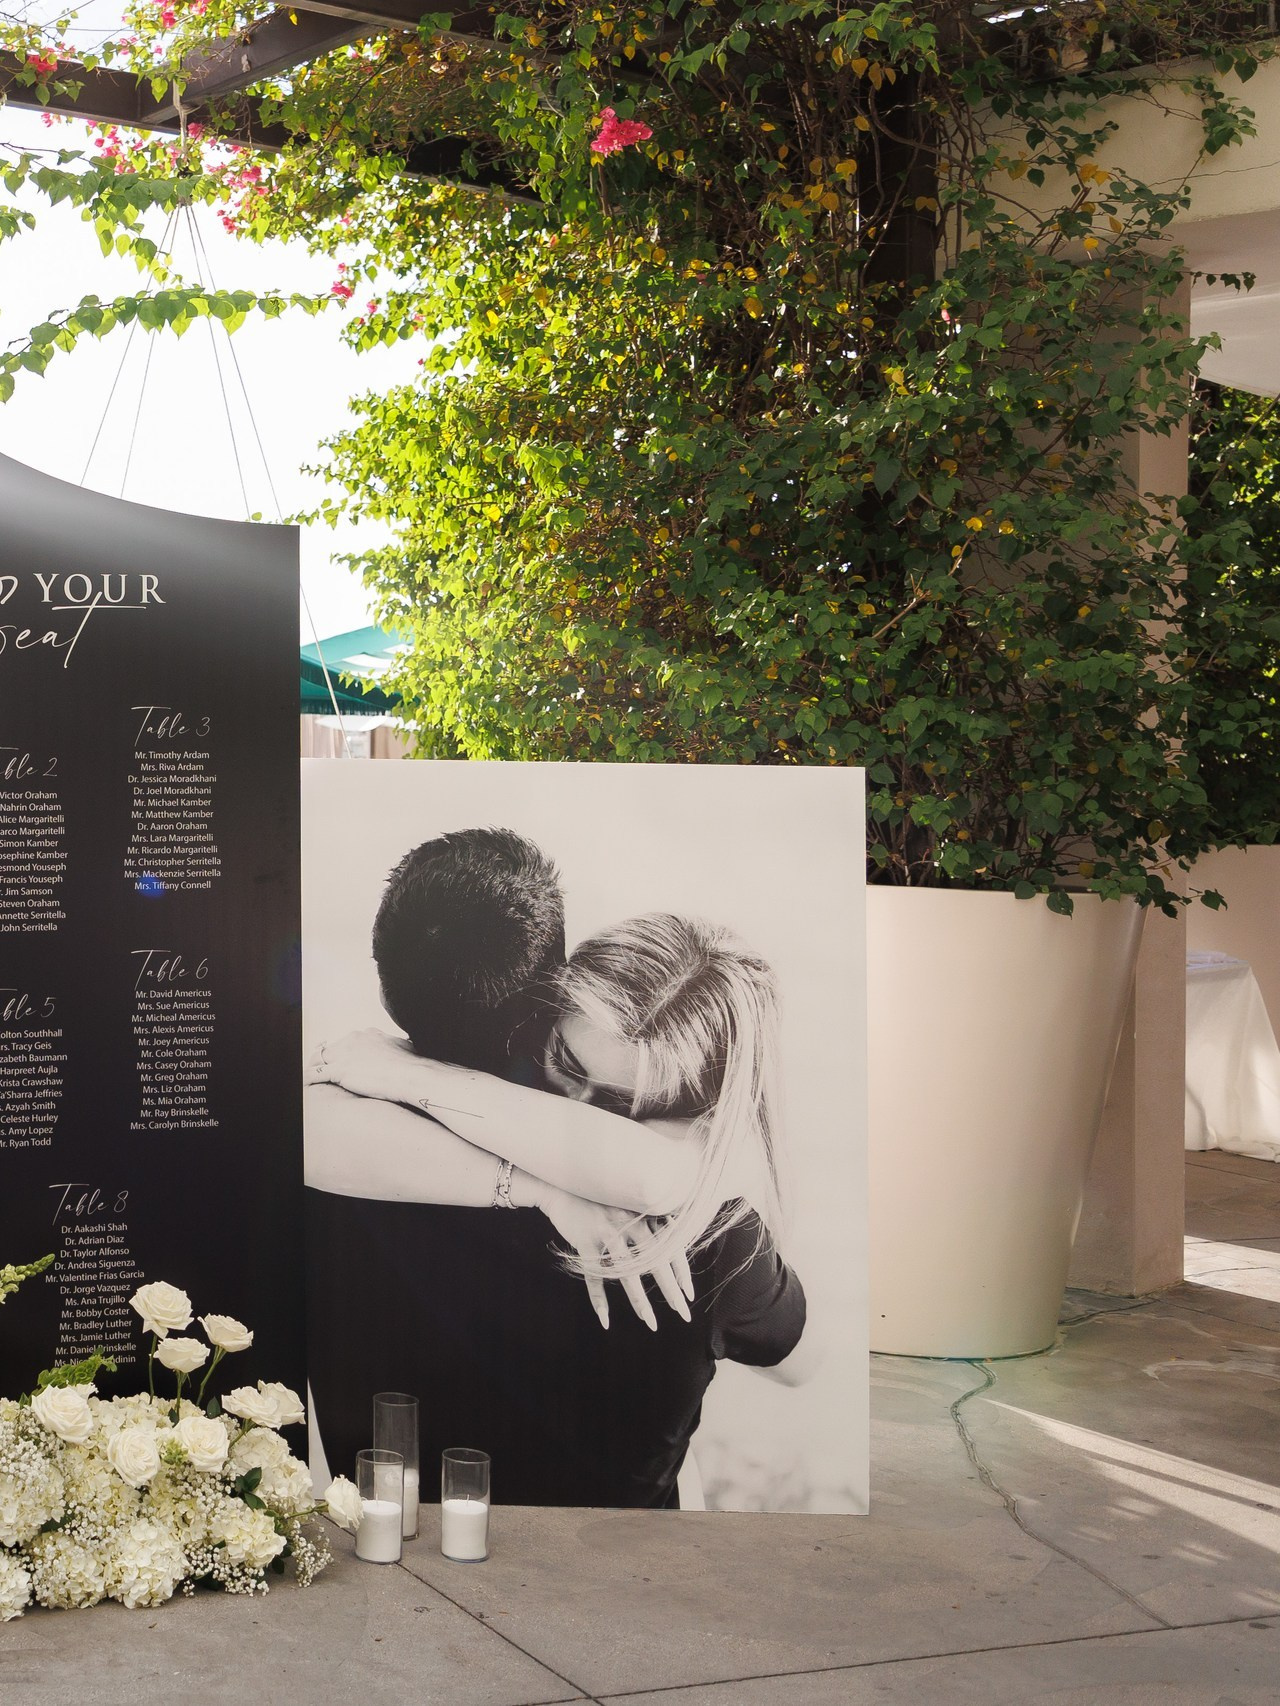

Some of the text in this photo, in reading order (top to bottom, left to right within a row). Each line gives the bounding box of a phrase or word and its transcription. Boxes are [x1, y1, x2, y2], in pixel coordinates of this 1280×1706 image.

[33, 572, 167, 603] YOUR
[131, 706, 211, 747] Table 3
[135, 751, 210, 761] Mr. Timothy Ardam
[42, 757, 58, 777] 2
[128, 775, 139, 783] Dr.
[141, 775, 168, 783] Jessica
[0, 791, 23, 799] Victor
[24, 791, 57, 799] Oraham
[0, 803, 27, 811] Nahrin
[28, 803, 62, 811] Oraham
[131, 810, 214, 819] Mr. Matthew Kamber
[36, 850, 68, 859] Kamber
[31, 862, 67, 872] Youseph
[124, 857, 221, 867] Mr. Christopher Serritella
[134, 880, 211, 891] Mrs. Tiffany Connell
[30, 910, 66, 919] Serritella
[131, 949, 209, 990] Table 6
[134, 989, 212, 998] Mr. David Americus
[40, 997, 57, 1018] 5
[131, 1012, 216, 1022] Mr. Micheal Americus
[133, 1024, 214, 1034] Mrs. Alexis Americus
[29, 1054, 68, 1062] Baumann
[0, 1066, 36, 1076] Harpreet
[34, 1089, 63, 1098] Jeffries
[143, 1084, 206, 1094] Mrs. Liz Oraham
[0, 1115, 30, 1124] Celeste
[31, 1113, 59, 1123] Hurley
[130, 1118, 219, 1130] Mrs. Carolyn Brinskelle
[9, 1139, 30, 1149] Ryan
[30, 1137, 51, 1146] Todd
[49, 1183, 129, 1226] Table 8
[61, 1225, 73, 1234] Dr.
[107, 1222, 128, 1232] Shah
[65, 1235, 124, 1246] Dr. Adrian Diaz
[54, 1262, 66, 1270] Dr.
[67, 1261, 97, 1270] Andrea
[45, 1270, 145, 1283] Mr. Valentine Frias Garcia
[65, 1295, 126, 1306] Ms. Ana Trujillo
[59, 1319, 132, 1331] Mr. Bradley Luther
